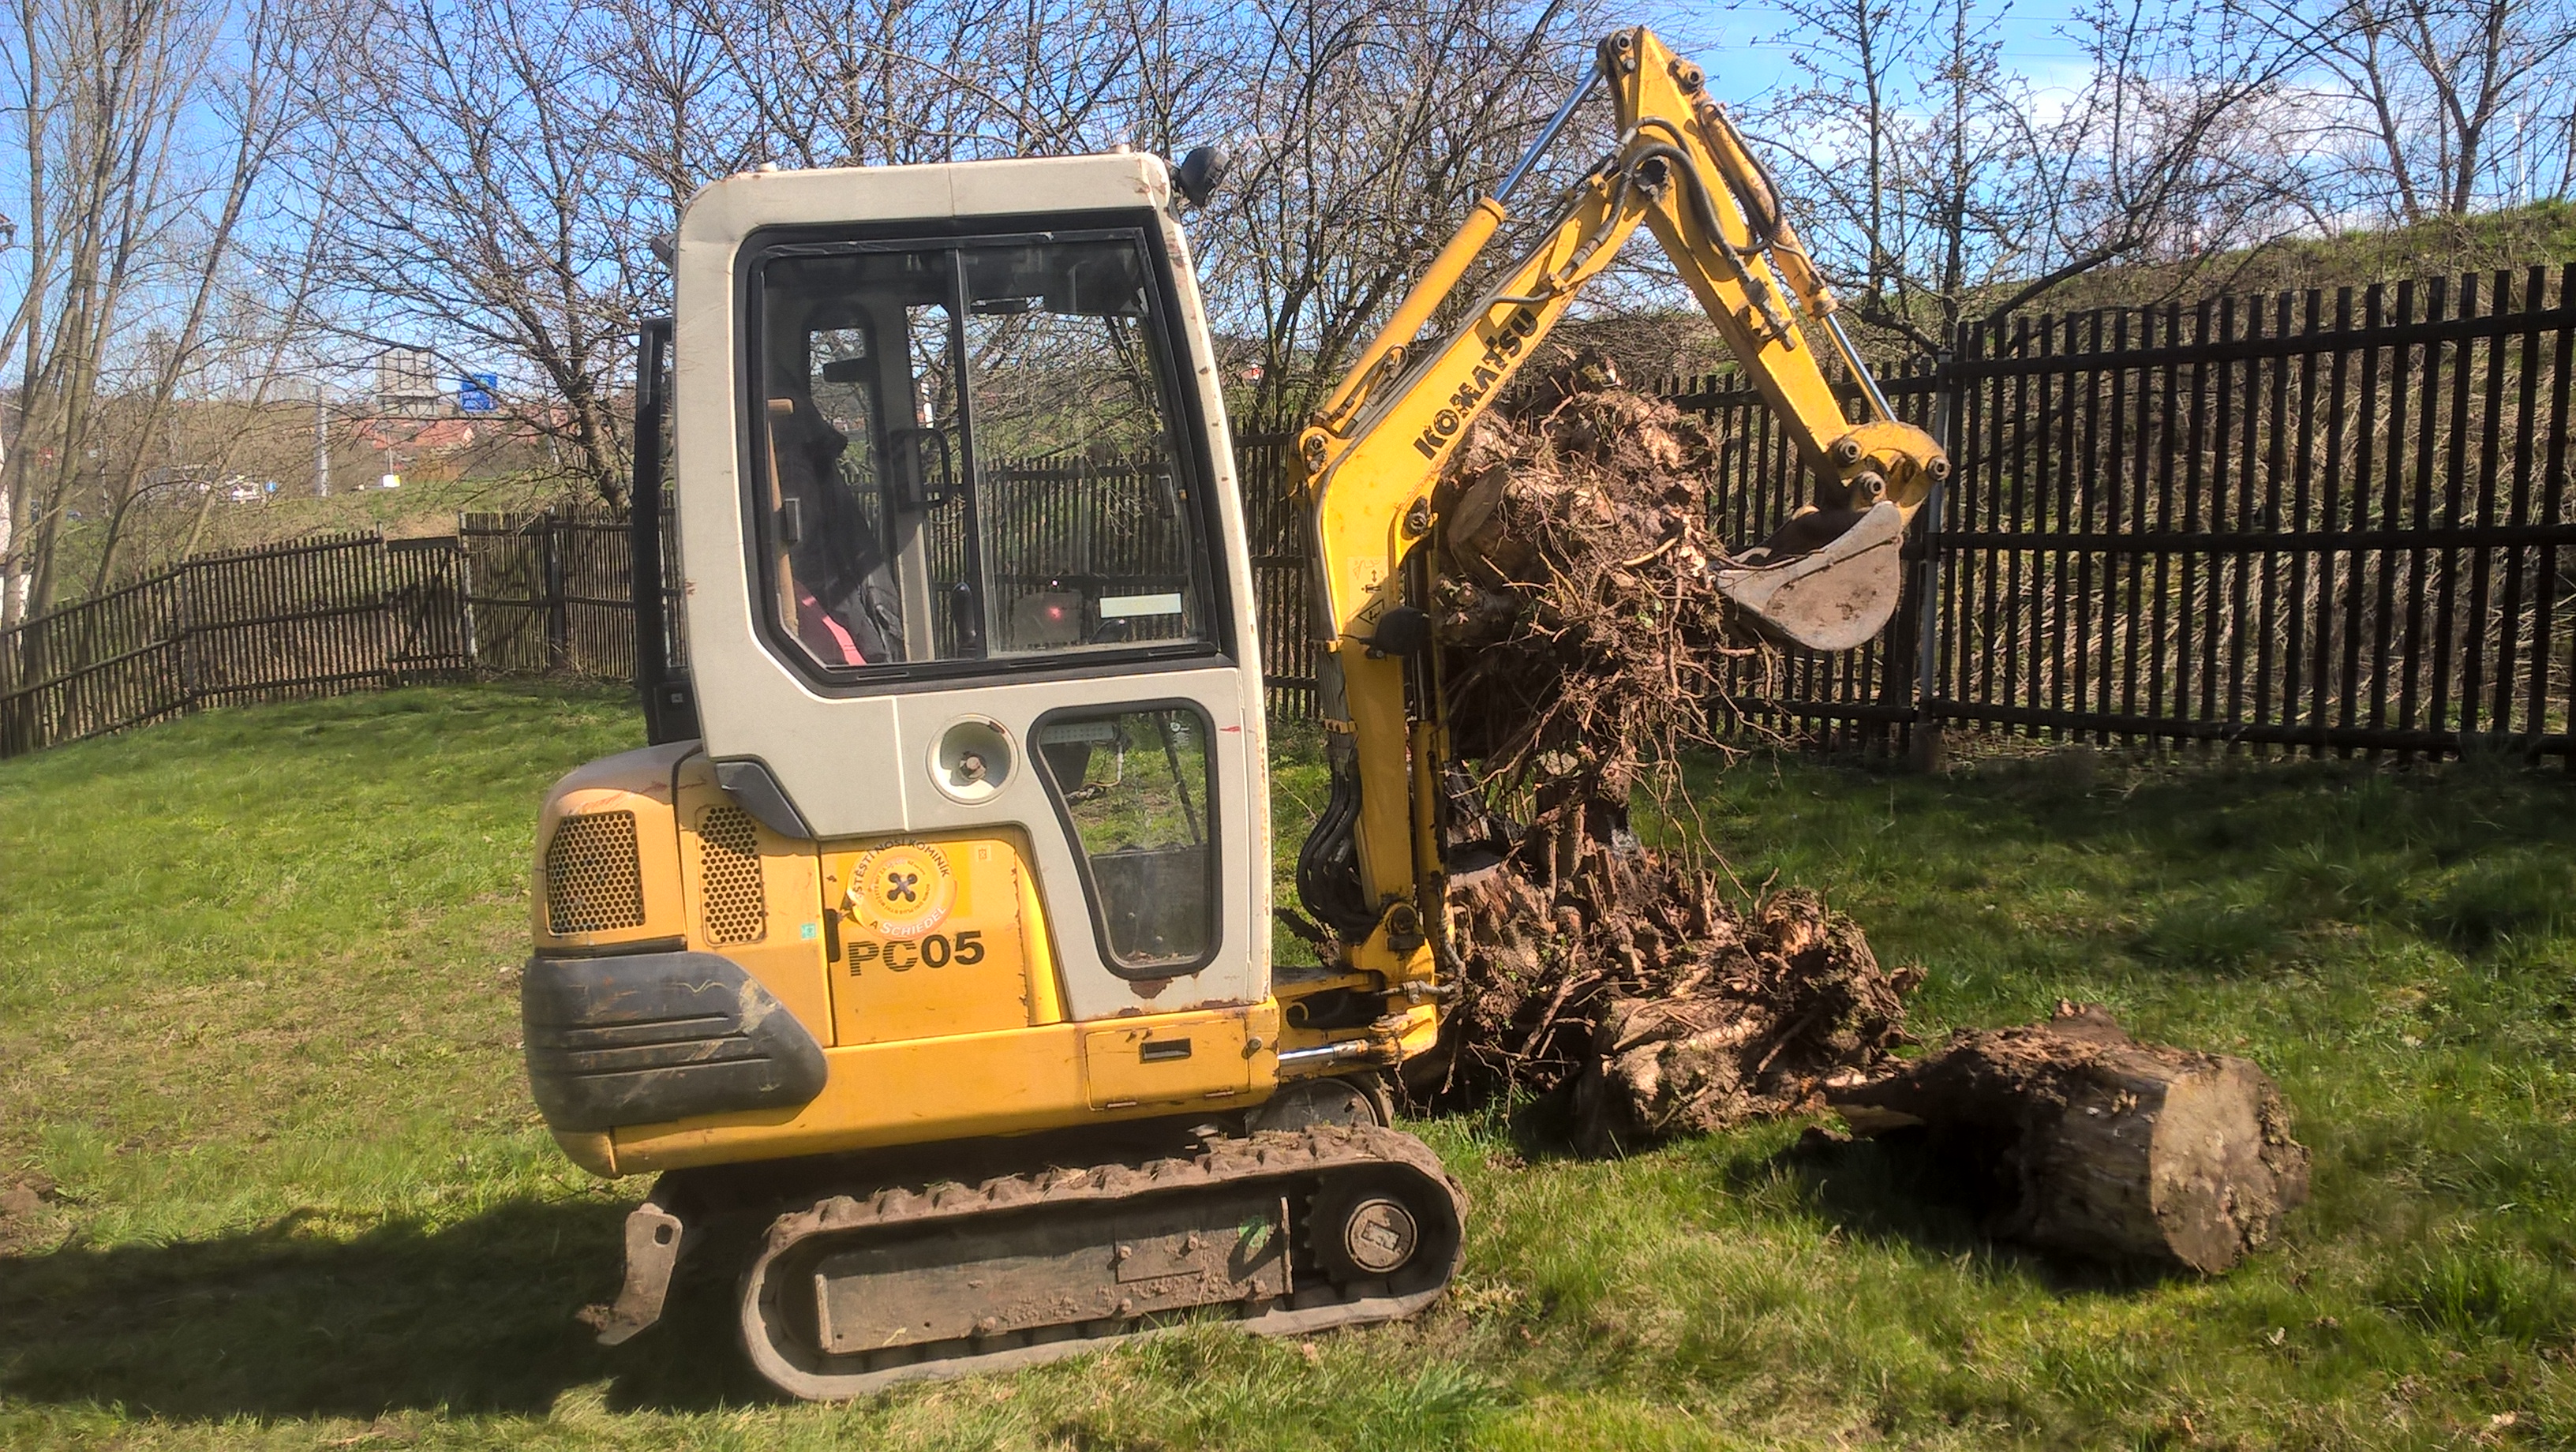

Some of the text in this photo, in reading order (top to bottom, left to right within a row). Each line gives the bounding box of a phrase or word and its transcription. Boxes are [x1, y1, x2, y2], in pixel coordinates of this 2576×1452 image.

[1413, 308, 1539, 461] KOMATSU
[869, 920, 879, 930] A
[880, 905, 947, 936] SCHIEDEL
[848, 930, 985, 977] PC05
